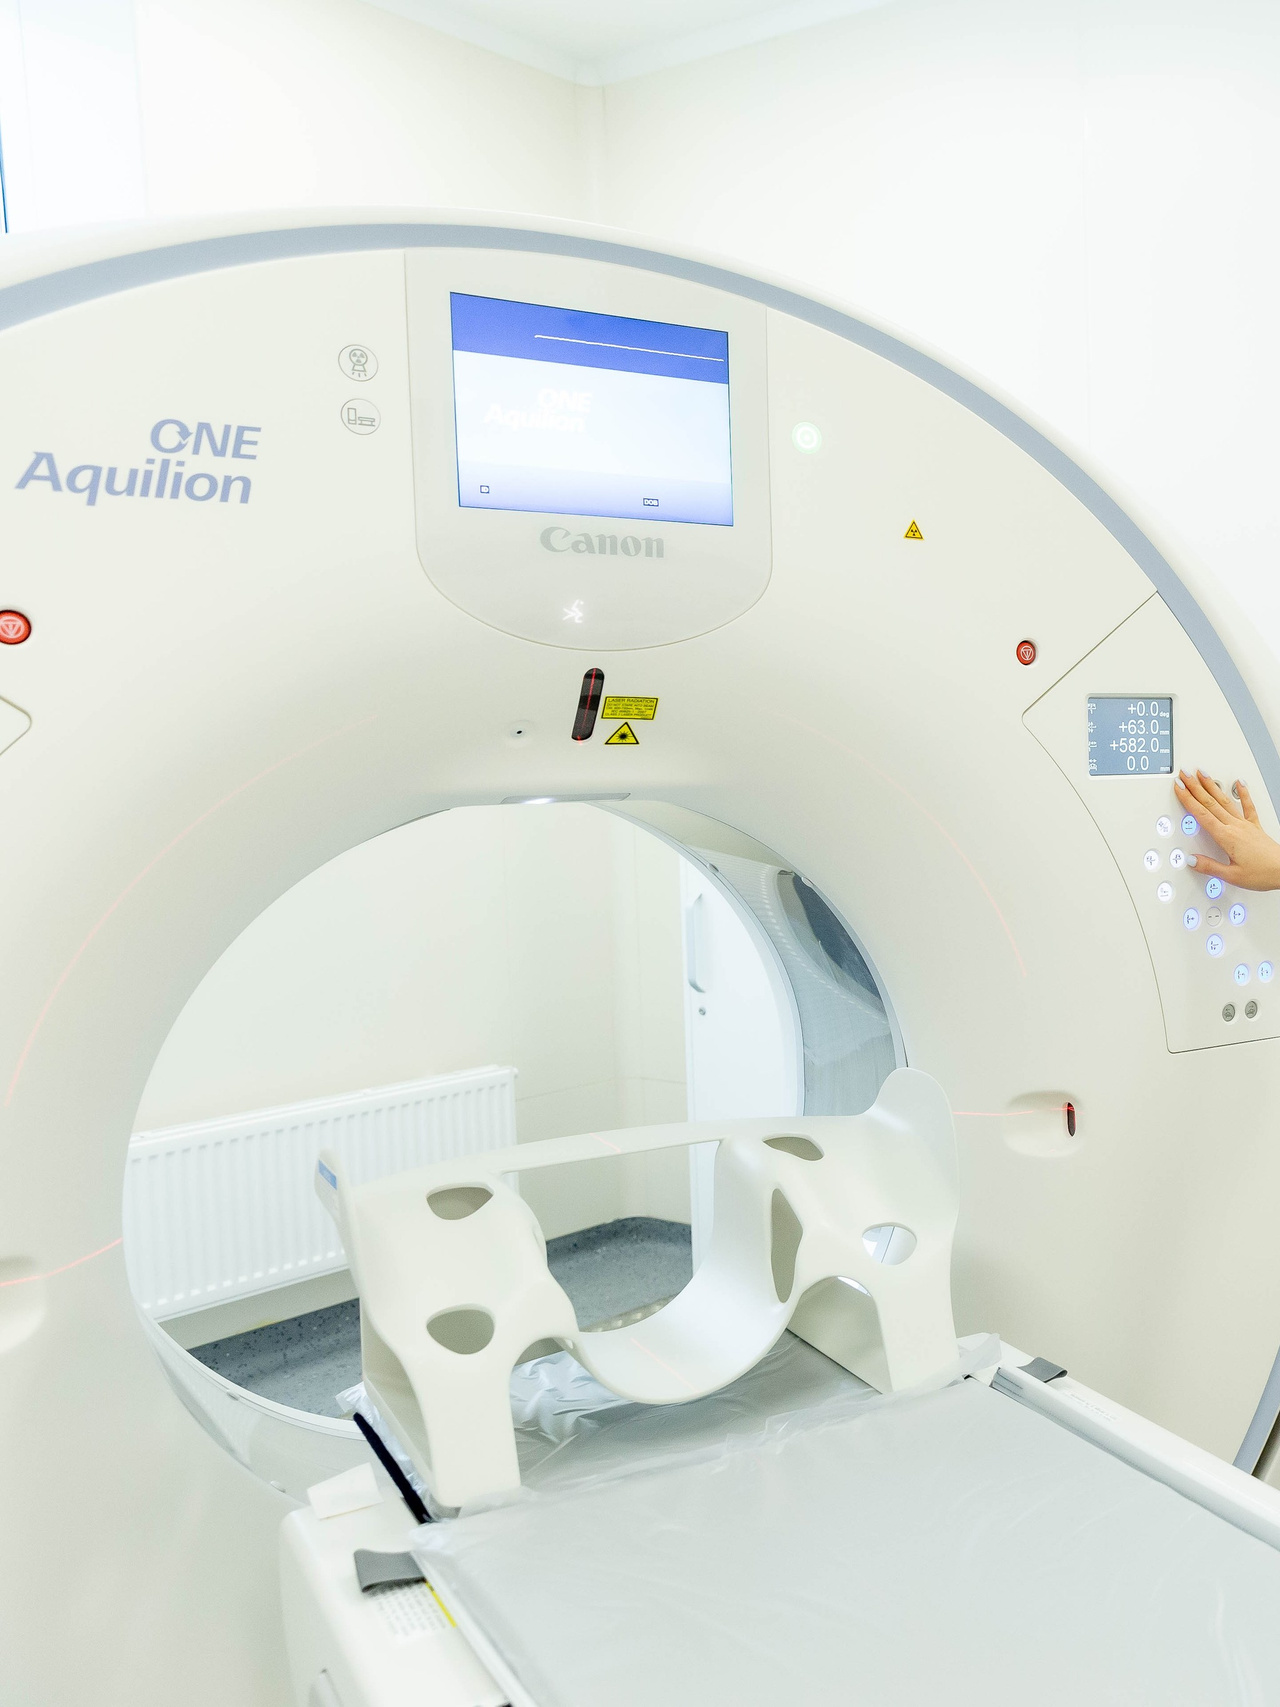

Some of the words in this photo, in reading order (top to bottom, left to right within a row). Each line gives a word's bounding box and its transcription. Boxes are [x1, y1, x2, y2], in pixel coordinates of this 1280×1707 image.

[536, 388, 593, 413] ONE
[483, 402, 587, 432] Aquilion
[150, 418, 262, 460] ONE
[14, 451, 252, 507] Aquilion
[540, 526, 664, 558] Canon
[1127, 701, 1159, 716] +0.0
[1118, 719, 1159, 734] +63.0
[1109, 738, 1160, 753] +582.0
[1126, 756, 1149, 771] 0.0
